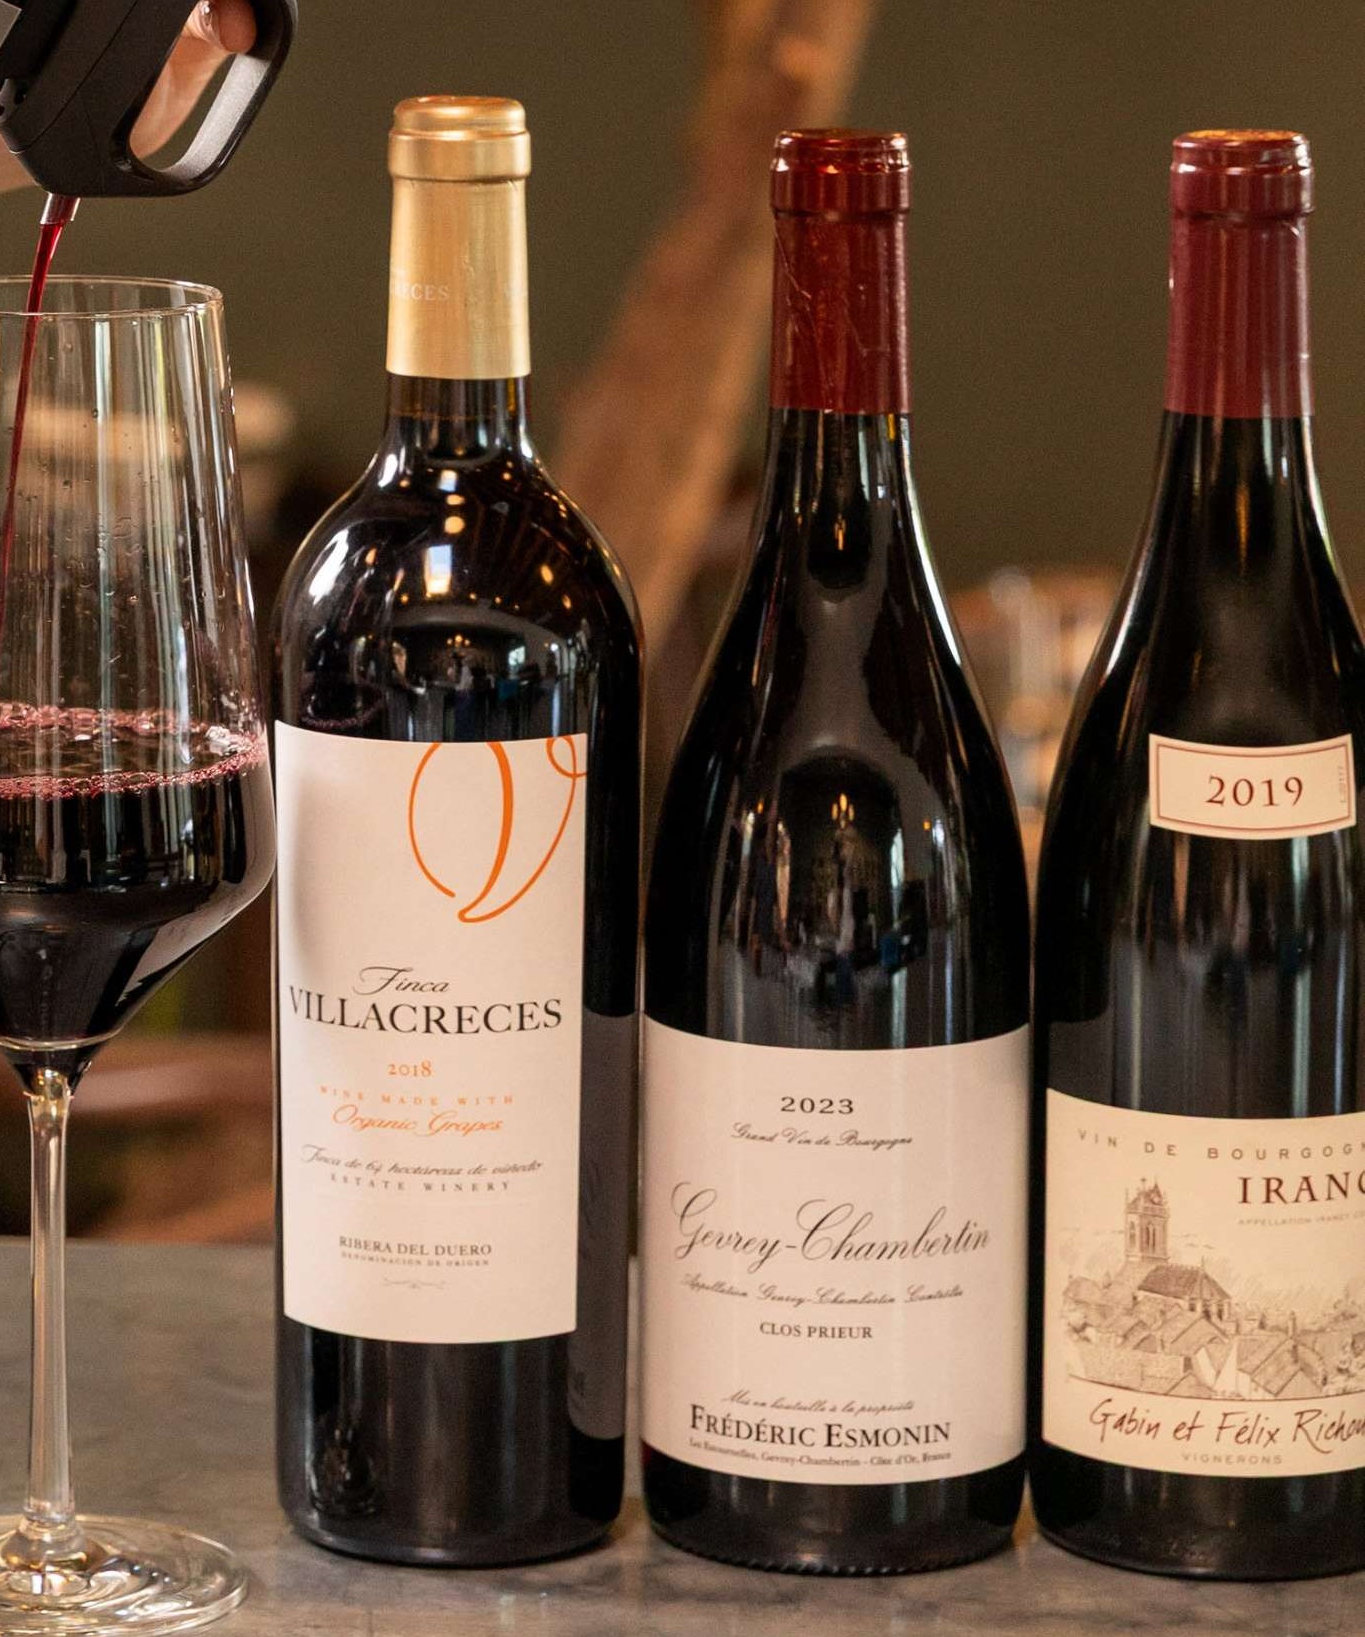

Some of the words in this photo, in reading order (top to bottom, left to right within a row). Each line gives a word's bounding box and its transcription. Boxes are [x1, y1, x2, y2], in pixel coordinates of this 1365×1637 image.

[1205, 774, 1305, 808] 2019
[352, 965, 450, 996] Finca
[288, 984, 563, 1036] VILLACRECES
[387, 1060, 432, 1078] 2018
[381, 1094, 439, 1107] MADE
[779, 1096, 854, 1115] 2023
[331, 1104, 418, 1132] Organic
[413, 1110, 504, 1137] Grapes
[1078, 1129, 1119, 1149] VIN
[1143, 1141, 1177, 1157] DE
[423, 1180, 511, 1193] WINERY
[671, 1181, 991, 1274] Gevrey-Chambertin
[338, 1235, 393, 1254] RIBERA
[397, 1242, 430, 1256] DEL
[434, 1243, 493, 1257] DUERO
[759, 1321, 802, 1339] CLOS
[807, 1324, 874, 1340] PRIEUR
[689, 1403, 816, 1448] FRÉDÉRIC
[823, 1421, 952, 1449] ESMONIN
[1088, 1396, 1162, 1444] Gabin
[1171, 1409, 1205, 1442] et
[1214, 1410, 1282, 1449] Félix
[1182, 1452, 1284, 1466] VIGNERONS
